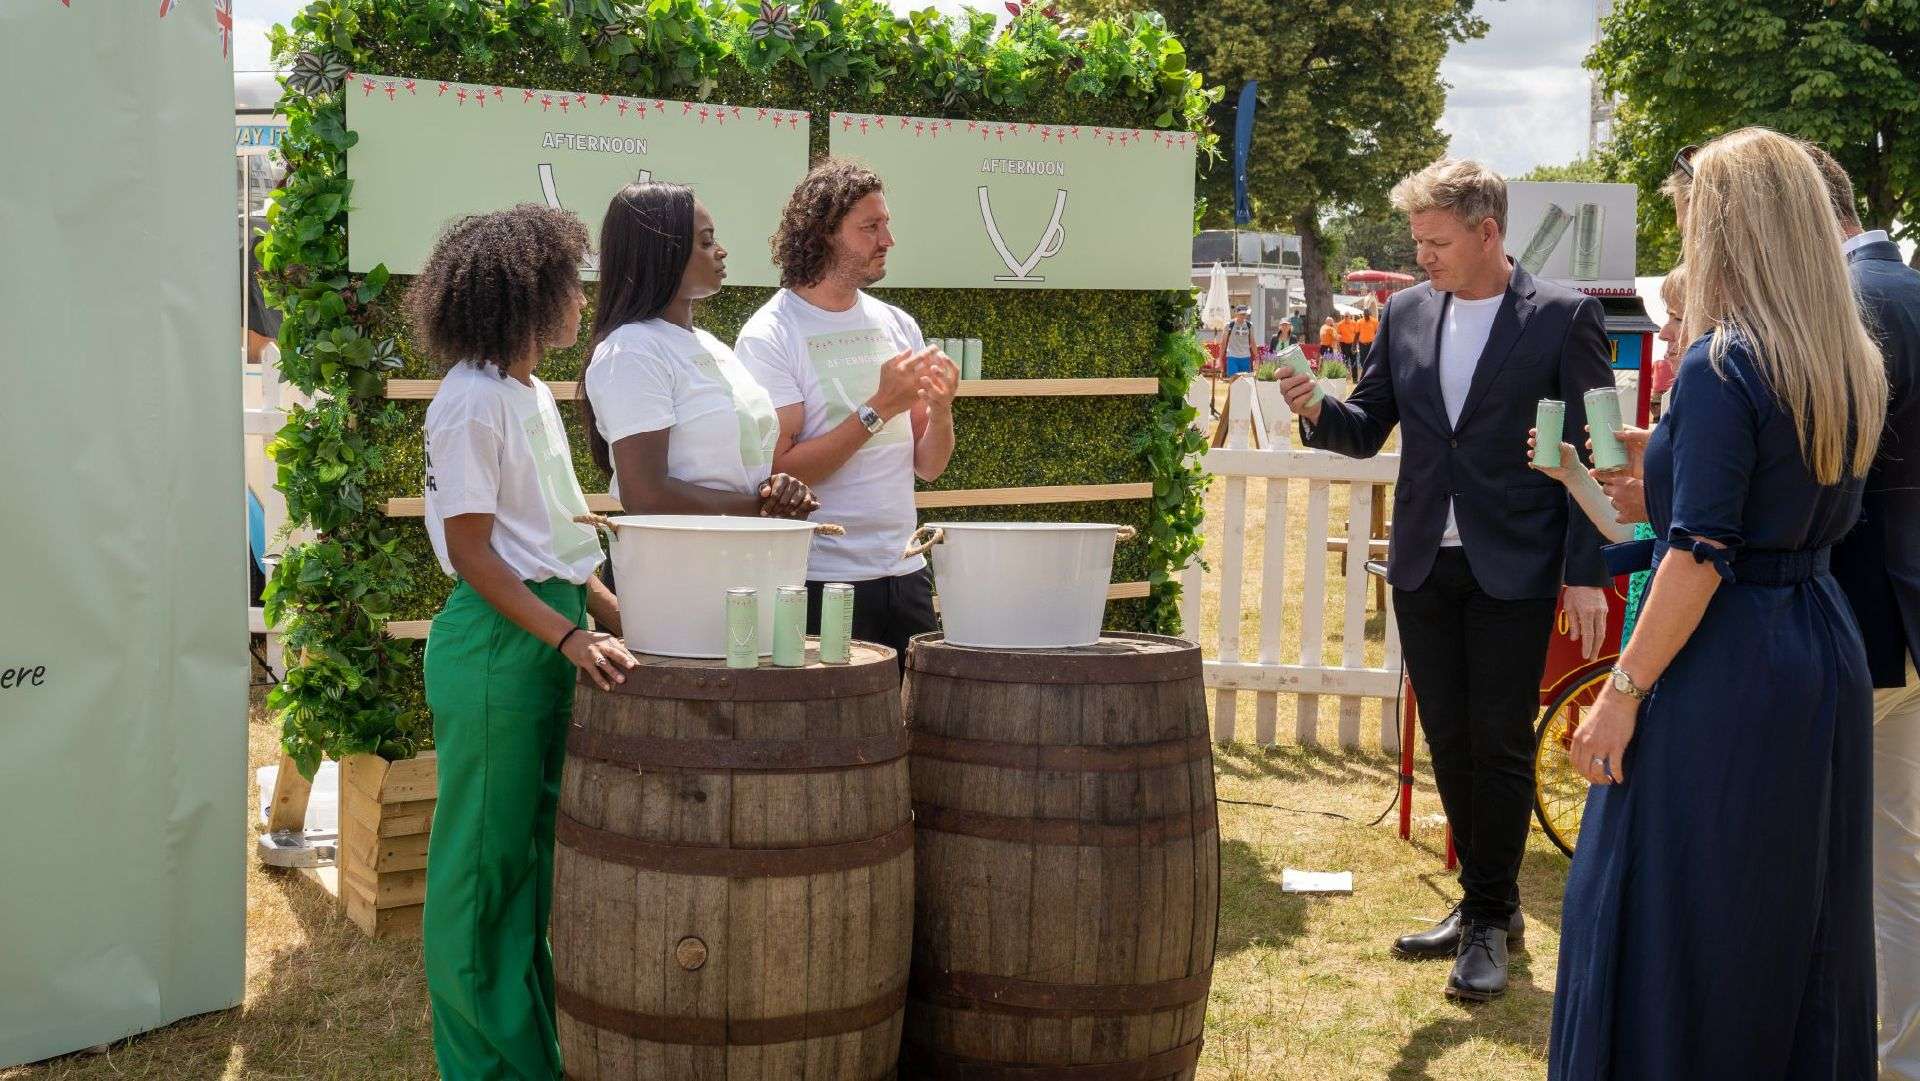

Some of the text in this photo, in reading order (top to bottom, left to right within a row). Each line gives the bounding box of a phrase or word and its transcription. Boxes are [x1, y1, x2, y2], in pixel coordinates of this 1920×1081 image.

[542, 131, 648, 155] AFTERNOON
[981, 158, 1065, 176] AFTERNOON
[1, 666, 46, 689] ere
